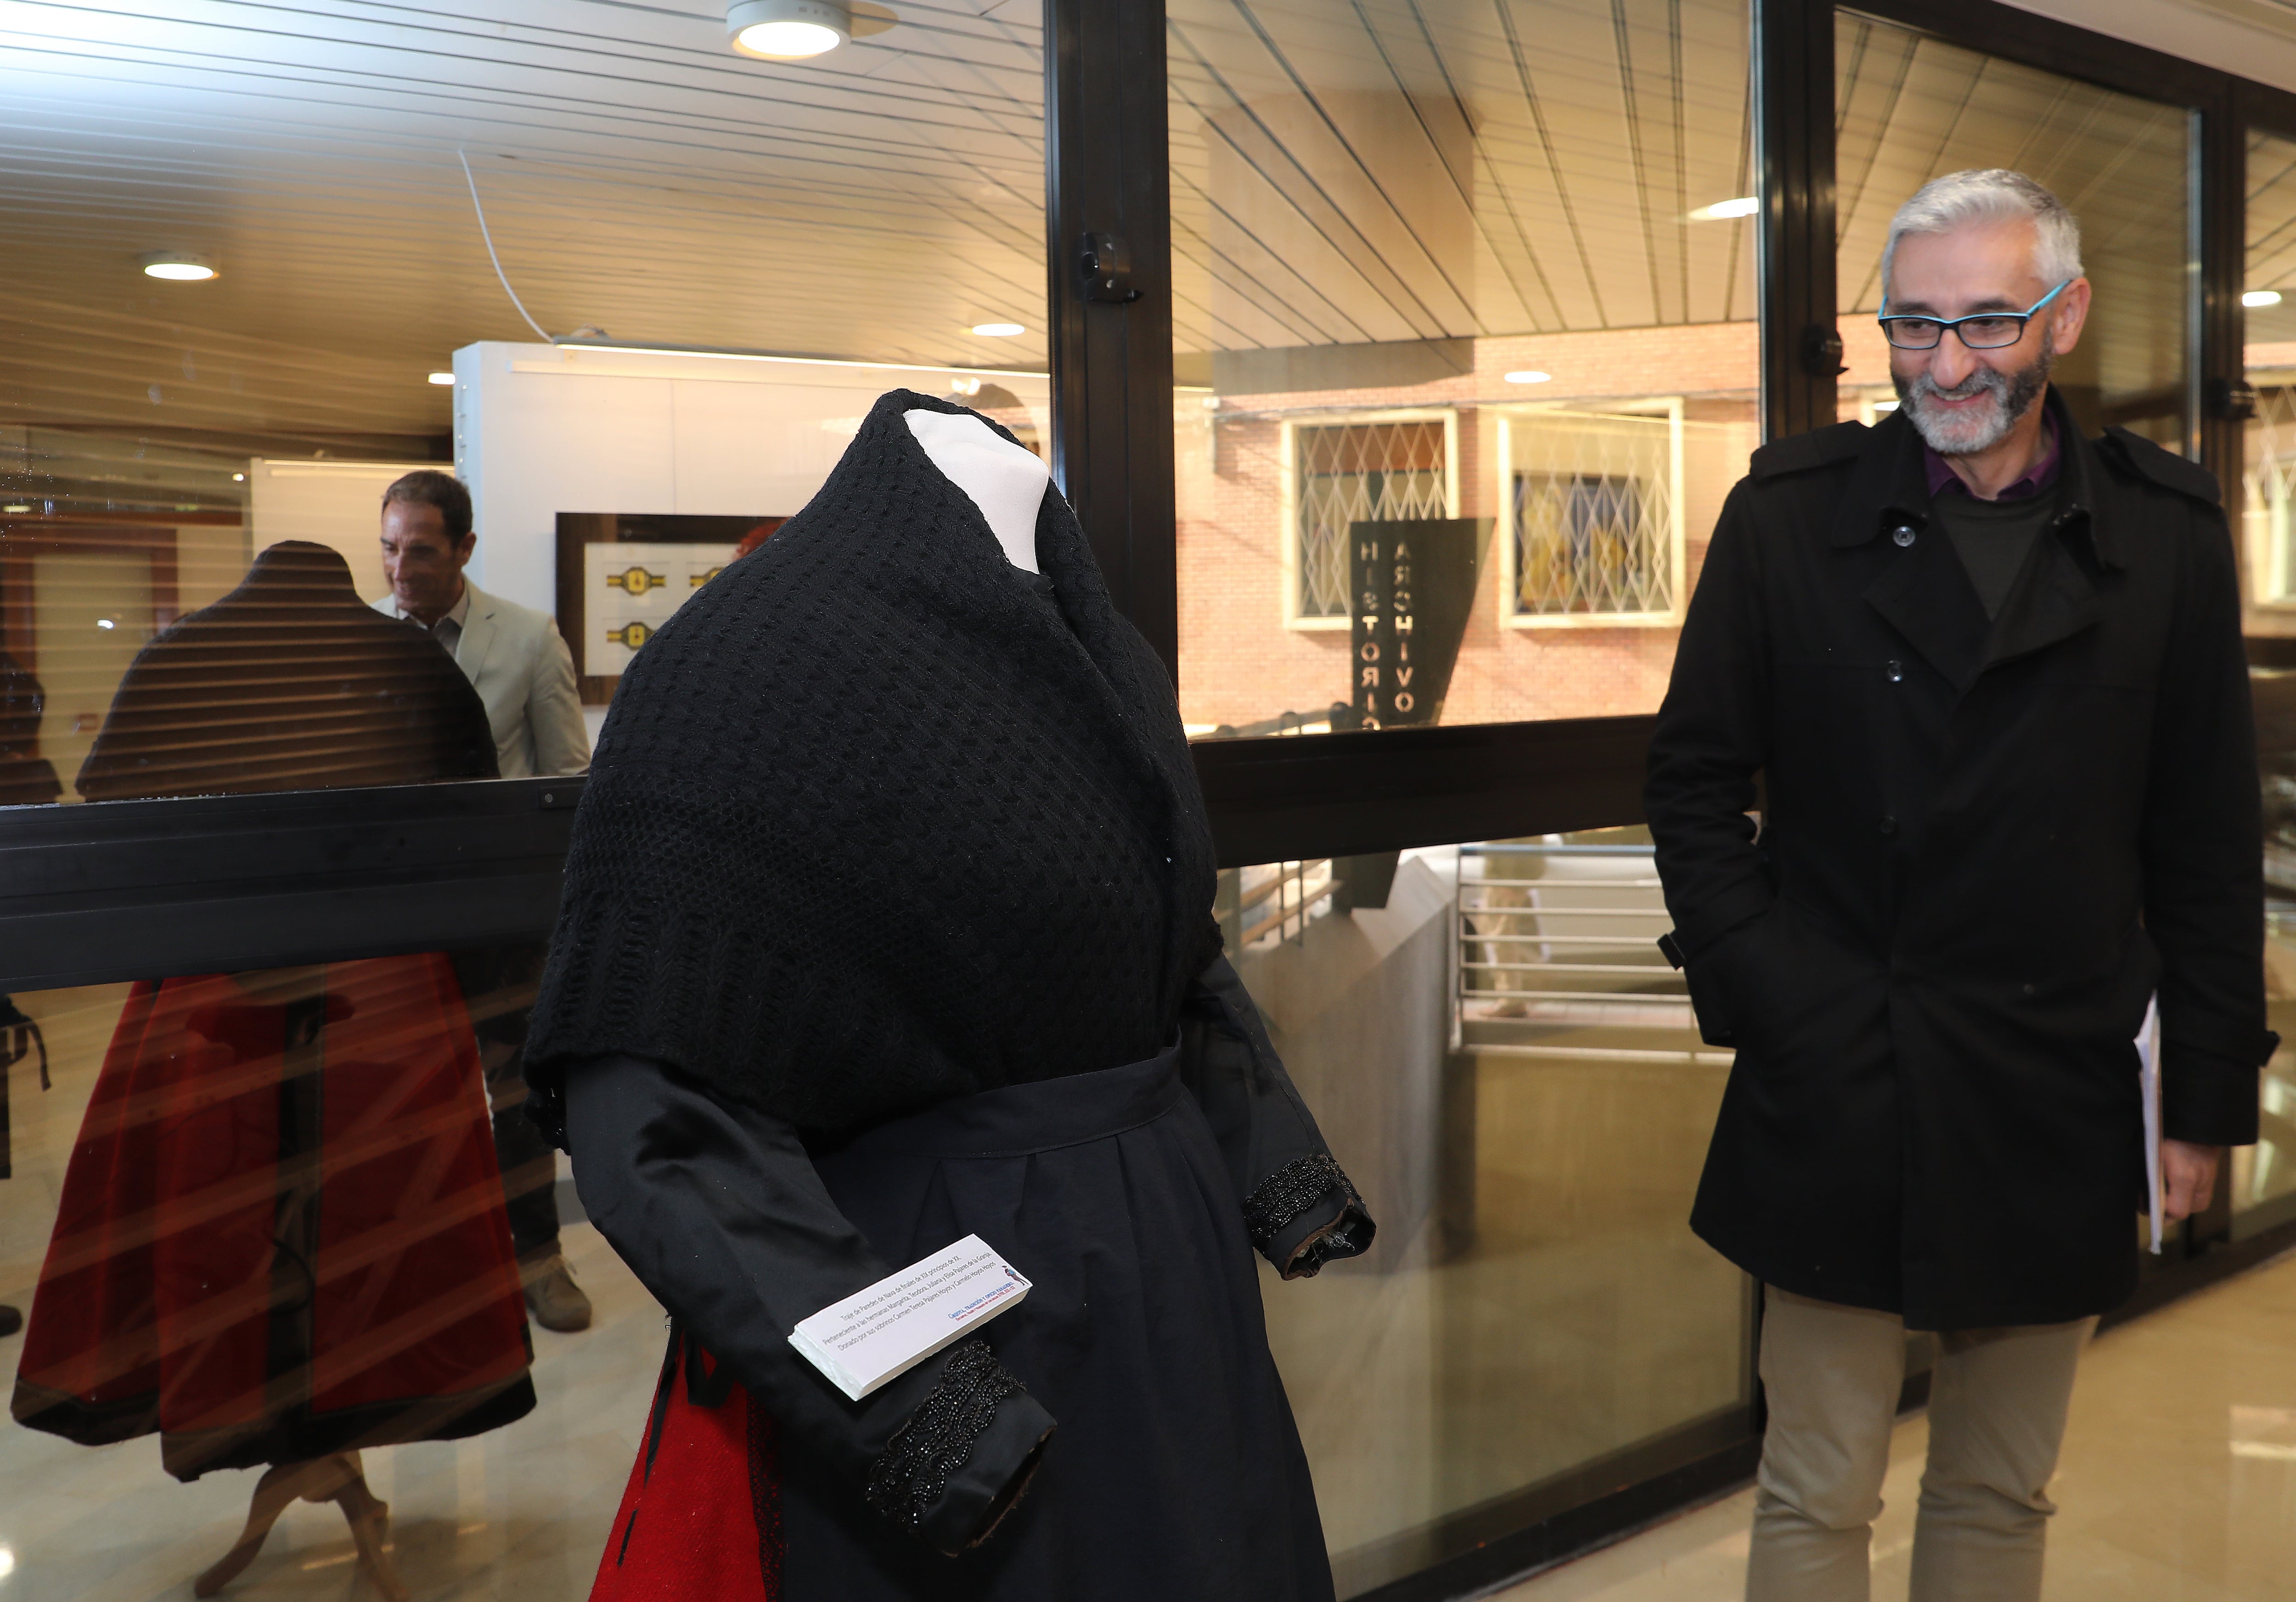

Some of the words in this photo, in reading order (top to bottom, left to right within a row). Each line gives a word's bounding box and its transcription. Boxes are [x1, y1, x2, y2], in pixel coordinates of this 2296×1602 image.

[822, 1325, 856, 1344] Perteneciente
[865, 1307, 889, 1321] hermanas
[927, 1278, 943, 1288] Juliana
[952, 1264, 969, 1274] Pajares
[976, 1252, 992, 1261] Granja.
[838, 1338, 859, 1350] Donado
[858, 1332, 867, 1341] por
[875, 1317, 895, 1330] sobrinos
[893, 1309, 912, 1320] Carmen
[909, 1301, 925, 1310] Teresa
[923, 1293, 940, 1303] Pajares
[937, 1286, 952, 1295] Hoyos
[953, 1275, 972, 1286] Carmelo
[969, 1268, 984, 1277] Hoyos
[981, 1262, 996, 1270] Hoyos
[859, 1300, 878, 1310] Paredes
[900, 1280, 916, 1289] finales
[928, 1262, 949, 1276] principios
